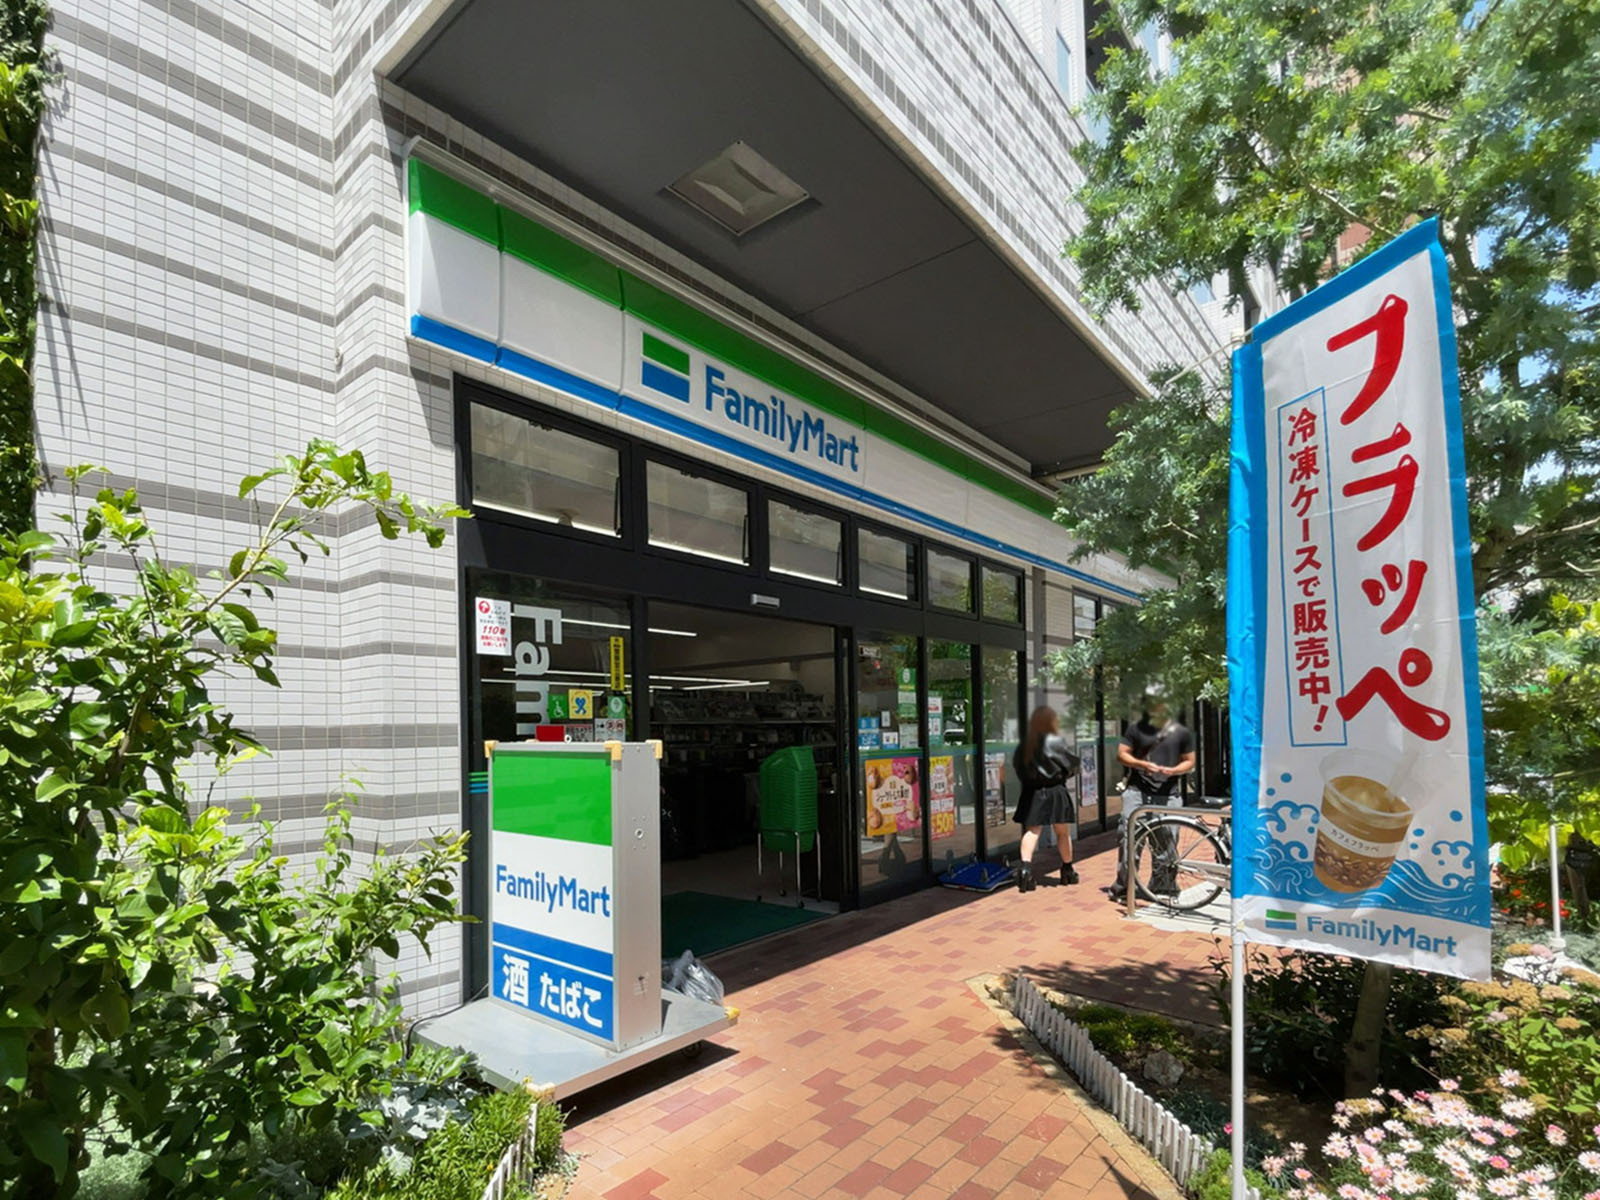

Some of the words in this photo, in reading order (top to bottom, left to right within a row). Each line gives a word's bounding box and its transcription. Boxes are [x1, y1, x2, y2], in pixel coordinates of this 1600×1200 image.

[705, 363, 859, 472] FamilyMart
[1326, 293, 1451, 741] フラッペ
[1287, 406, 1332, 733] 冷凍ケースで販売中!
[495, 864, 611, 918] FamilyMart
[1306, 916, 1457, 957] FamilyMart
[502, 953, 530, 1008] 酒
[539, 971, 603, 1029] たばこ
